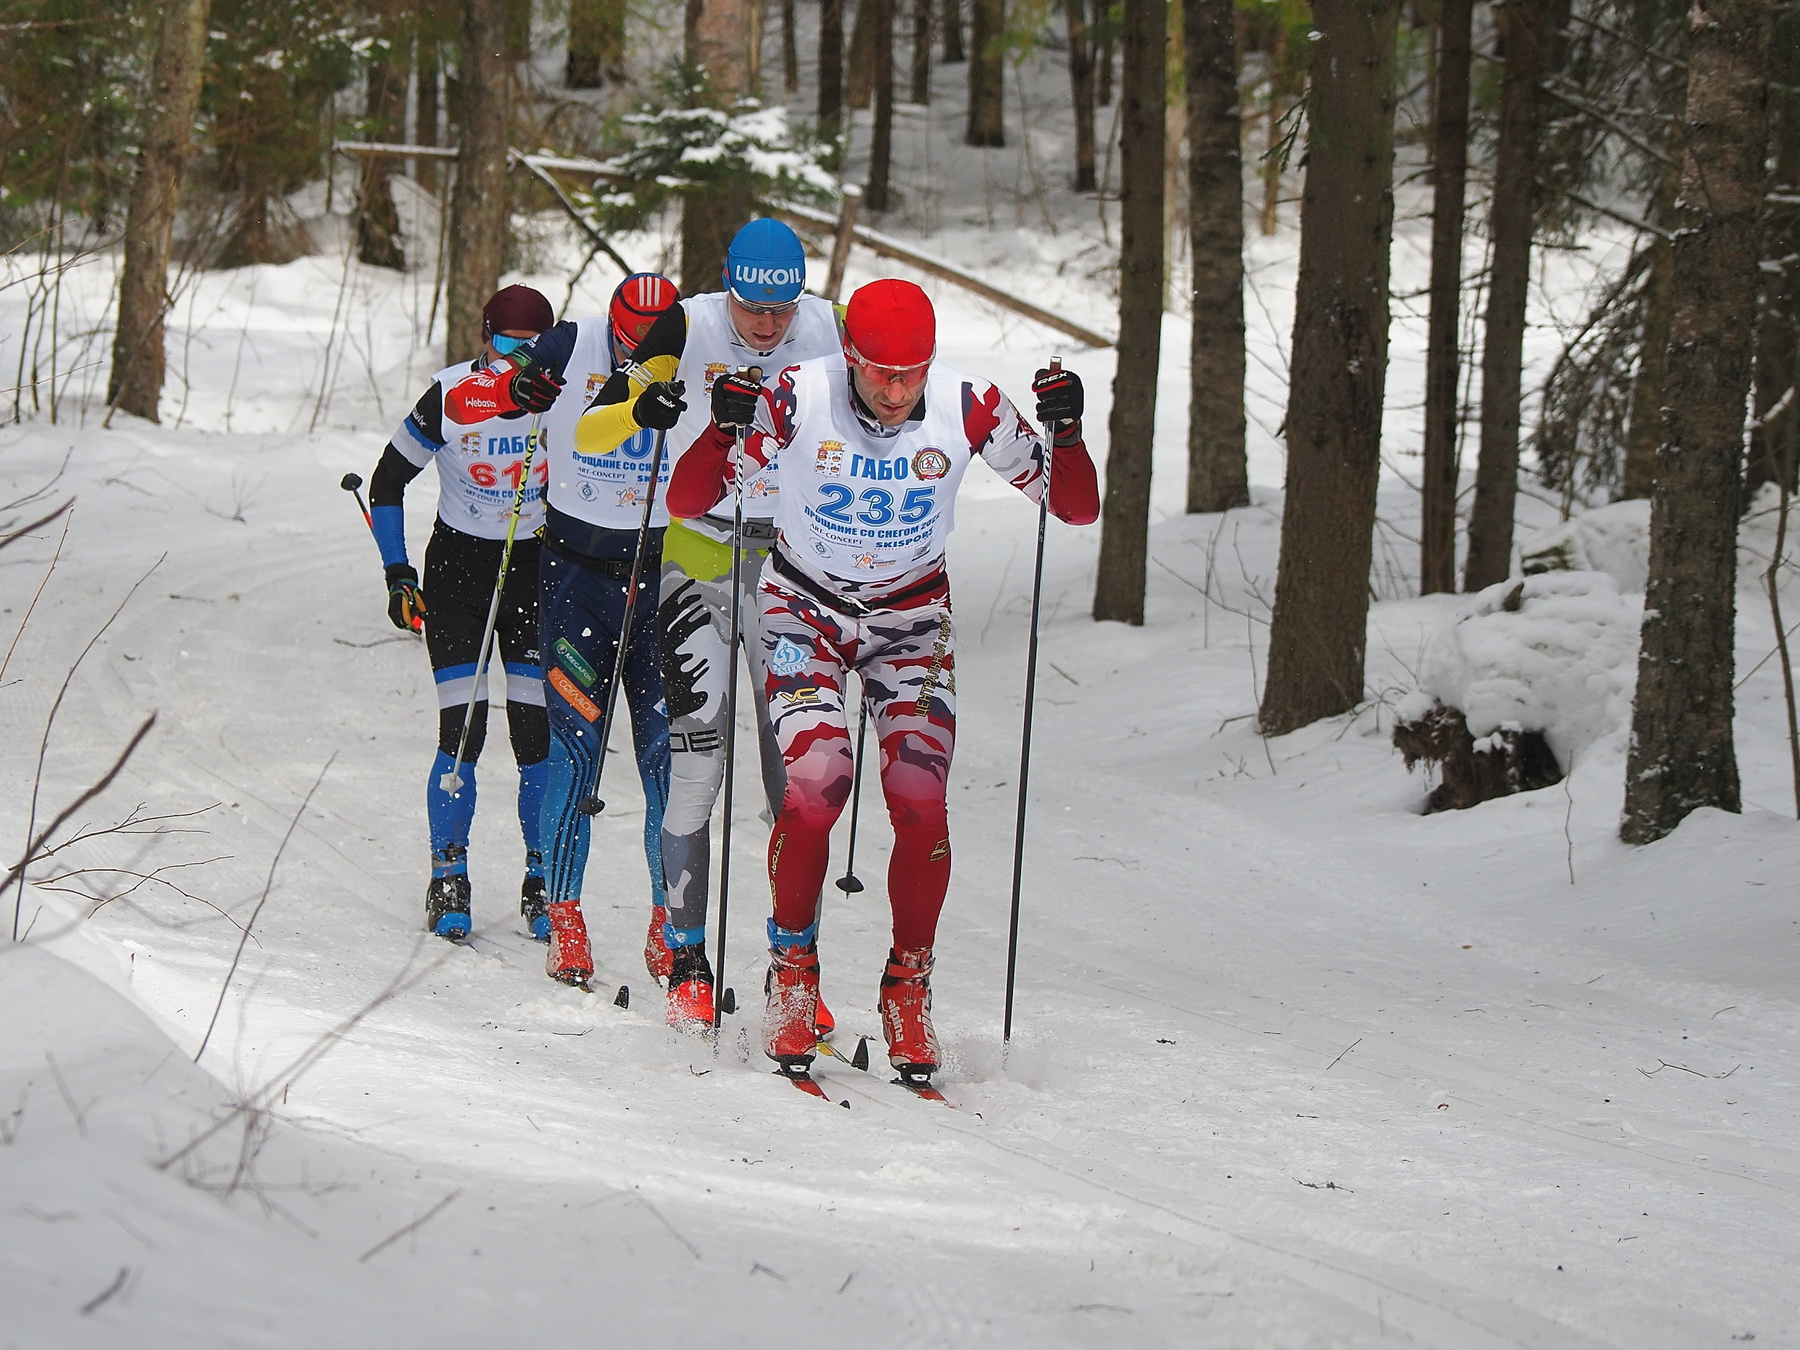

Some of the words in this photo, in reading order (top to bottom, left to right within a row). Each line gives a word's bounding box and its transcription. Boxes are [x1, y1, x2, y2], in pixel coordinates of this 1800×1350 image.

[735, 264, 801, 285] LUKOIL
[728, 376, 760, 390] REX
[1037, 371, 1068, 386] REX
[578, 466, 626, 479] ART-CONCEPT
[623, 461, 636, 470] СО
[850, 453, 908, 481] ГАБО
[464, 489, 505, 504] ART-CONCEPT
[502, 490, 514, 498] СО
[815, 482, 936, 527] 235
[804, 504, 858, 536] ПРОЩАНИЕ
[860, 529, 875, 538] СО
[877, 525, 919, 538] СНЕГОМ
[810, 523, 862, 544] ART-CONCEPT
[875, 526, 934, 548] SKISPORT
[564, 652, 592, 681] MEGAFON
[559, 679, 598, 717] СОГЛАСИЕ
[770, 833, 787, 878] VICTORY
[887, 998, 904, 1043] alpina
